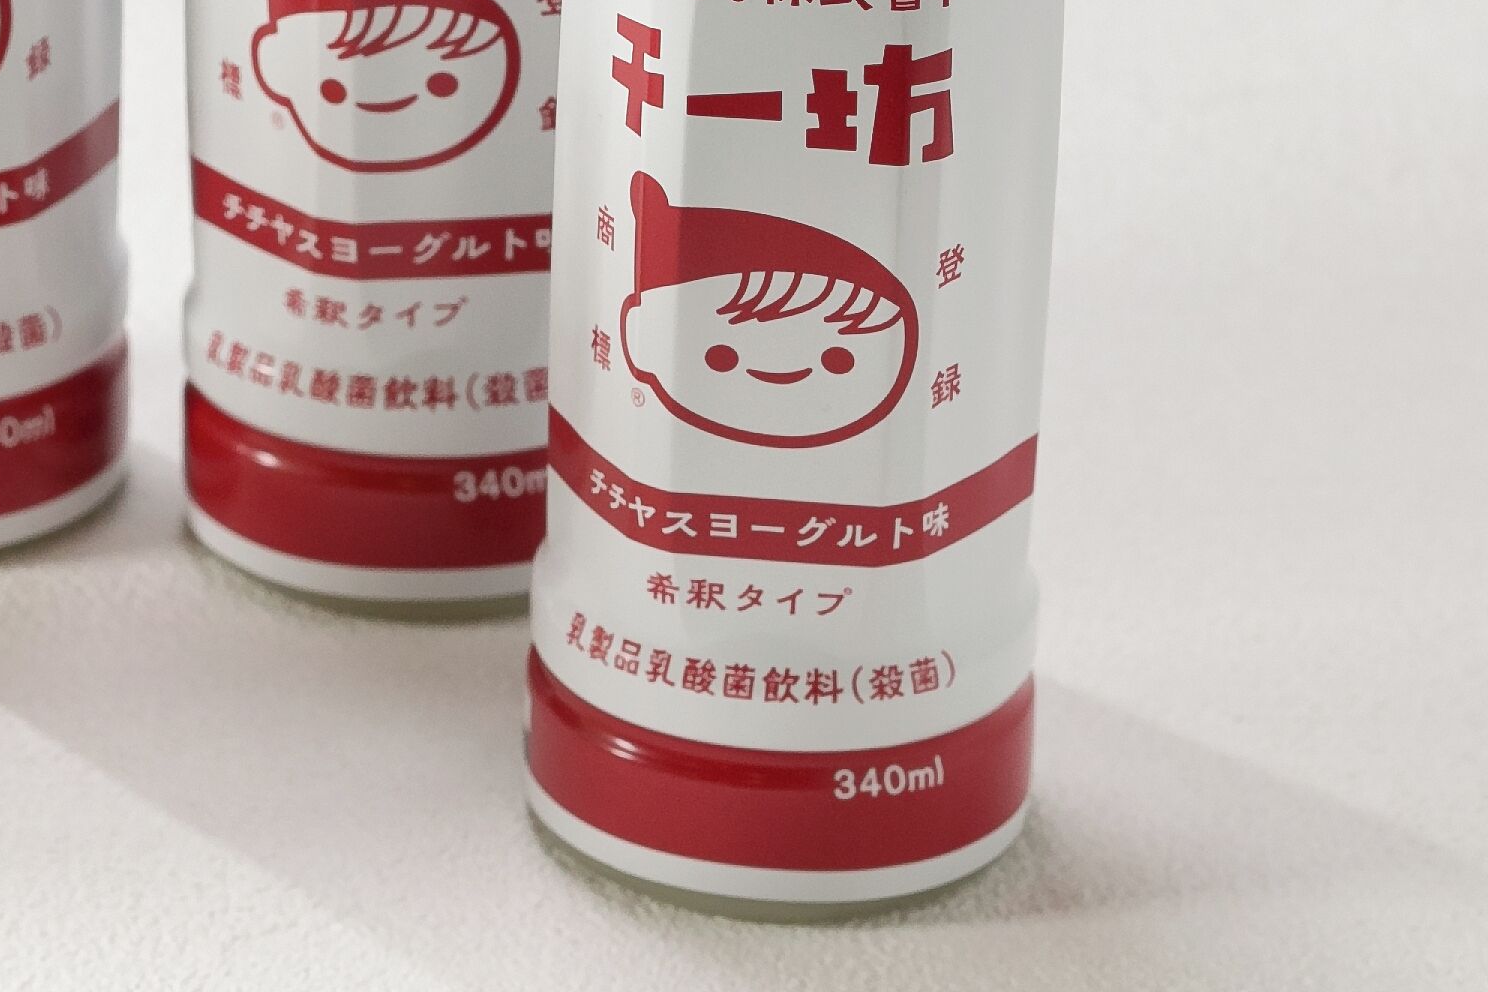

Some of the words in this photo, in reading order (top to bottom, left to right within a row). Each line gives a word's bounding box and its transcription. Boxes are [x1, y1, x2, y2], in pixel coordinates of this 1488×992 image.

[611, 13, 954, 167] チー坊
[589, 468, 950, 550] チチヤスヨーグルト味
[646, 571, 853, 616] 希釈タイプ
[566, 610, 957, 706] 乳製品乳酸菌飲料(殺菌)
[833, 754, 944, 801] 340ml
